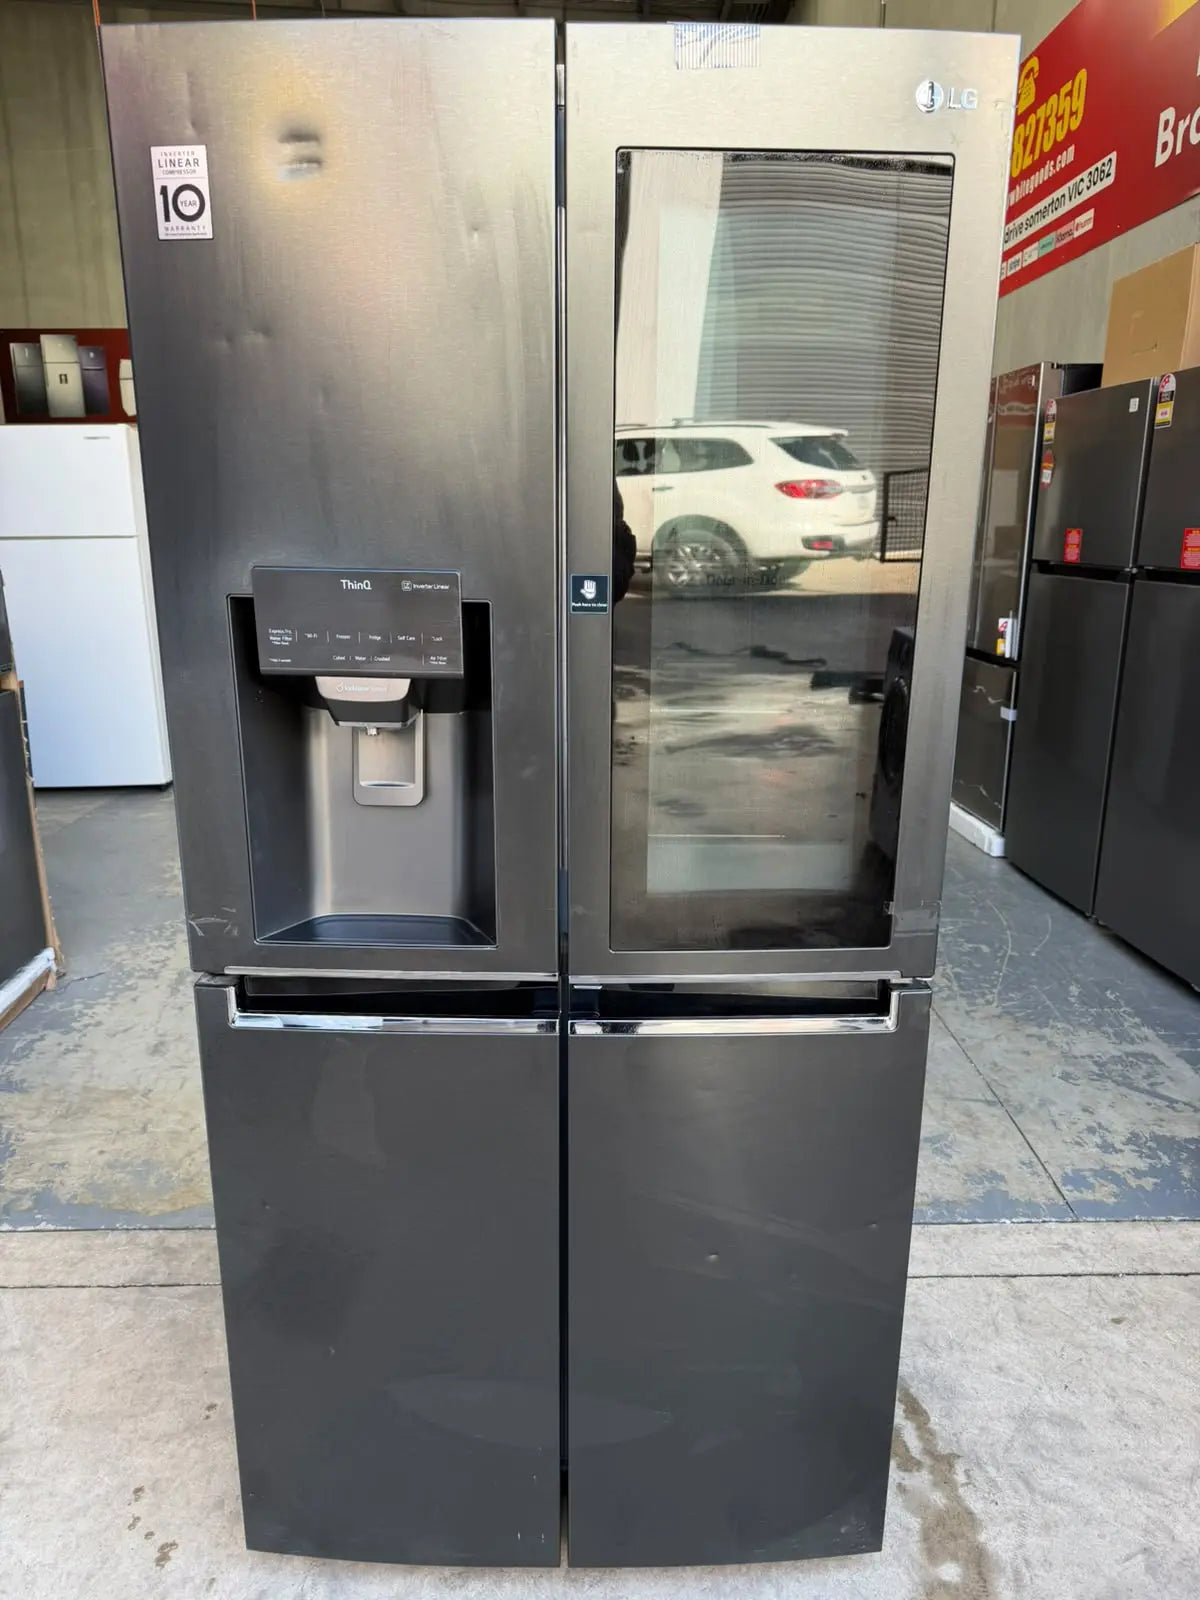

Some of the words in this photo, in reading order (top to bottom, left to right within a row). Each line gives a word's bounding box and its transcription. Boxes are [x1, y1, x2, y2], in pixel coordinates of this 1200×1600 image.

[947, 87, 978, 110] LG
[157, 158, 200, 168] LINEAR
[159, 183, 206, 222] 10
[1024, 193, 1066, 231] somerton
[1067, 177, 1085, 203] VIC
[1086, 157, 1113, 191] 3062
[340, 579, 372, 590] ThinQ
